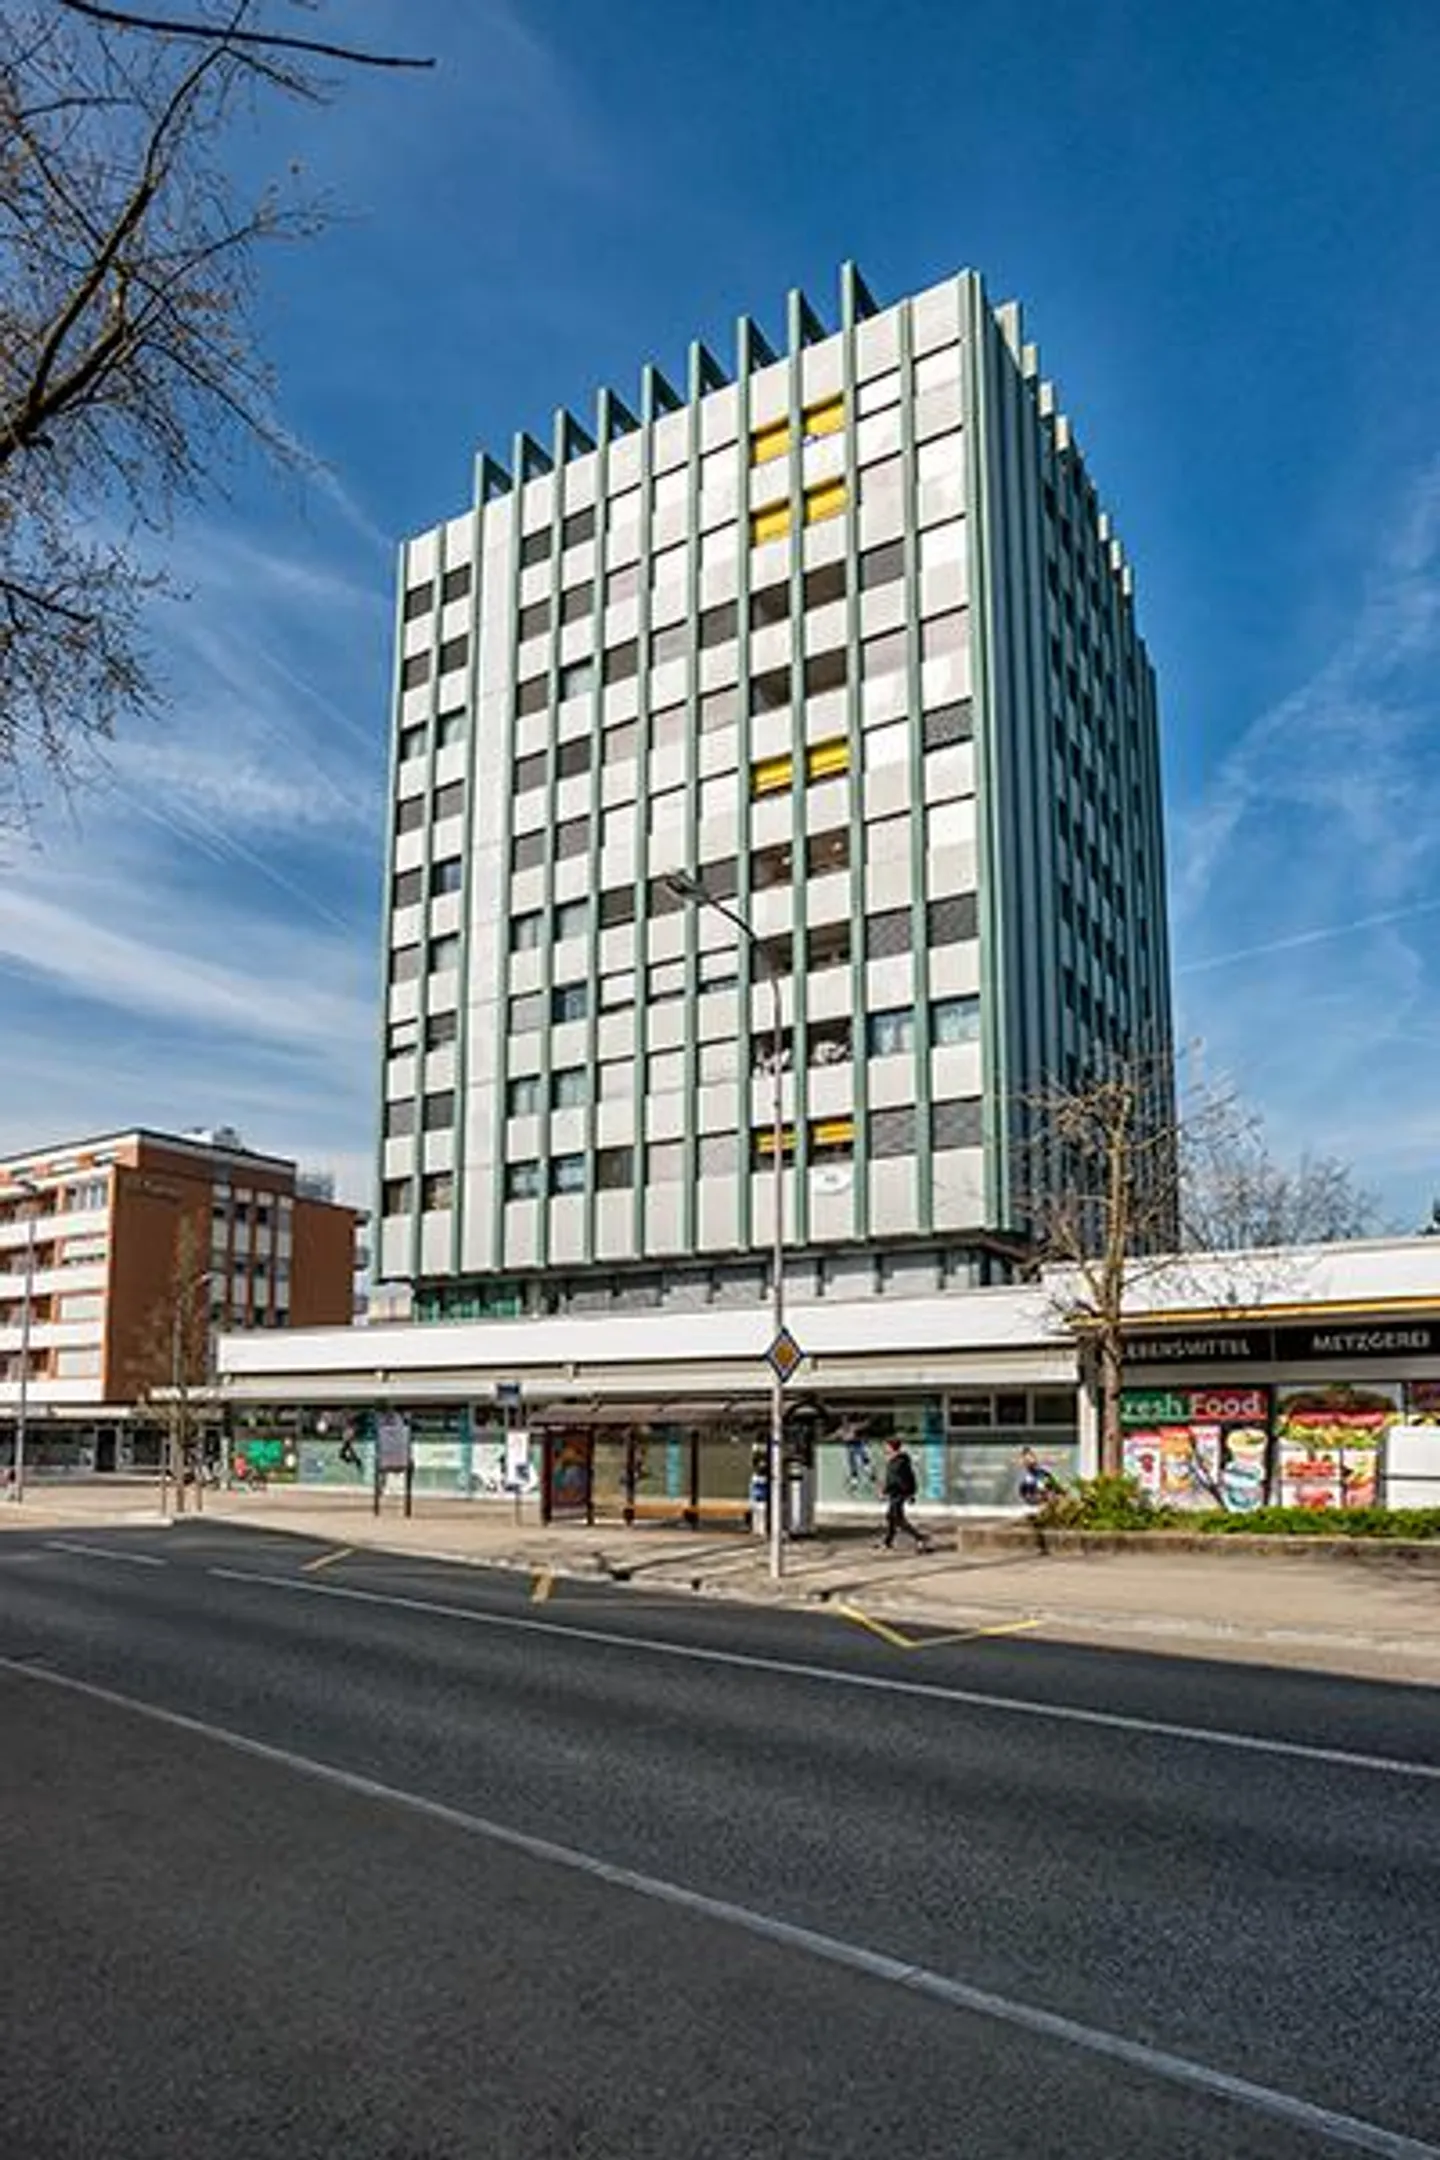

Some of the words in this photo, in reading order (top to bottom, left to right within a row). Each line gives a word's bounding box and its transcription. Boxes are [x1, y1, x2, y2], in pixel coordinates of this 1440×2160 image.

[1122, 1338, 1251, 1359] EBENSMITTEL
[1311, 1330, 1430, 1352] METZGEREI
[1121, 1393, 1183, 1416] resh
[1188, 1390, 1260, 1416] Food
